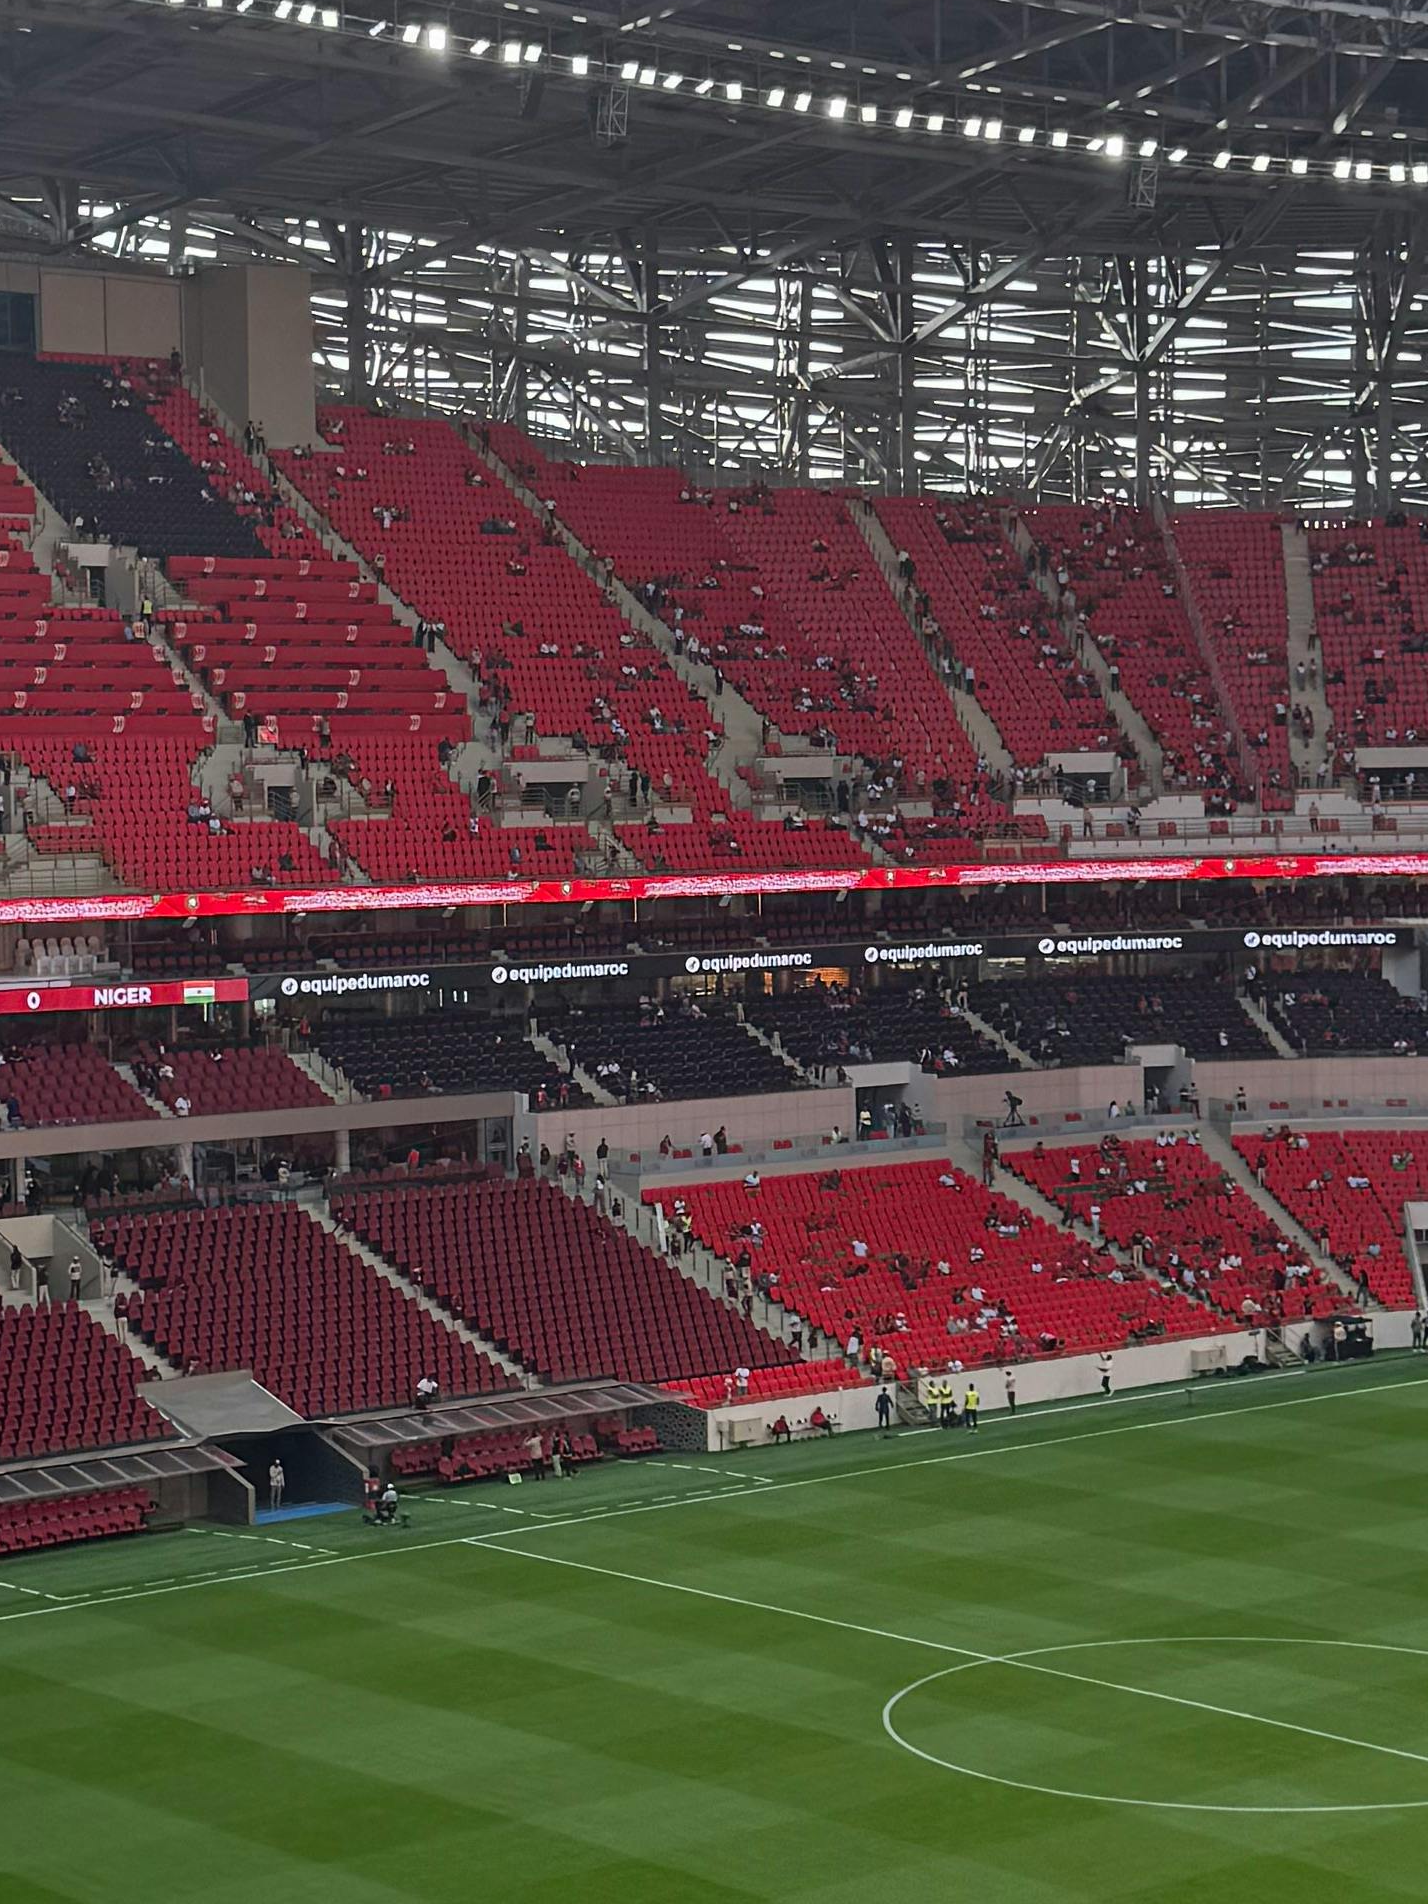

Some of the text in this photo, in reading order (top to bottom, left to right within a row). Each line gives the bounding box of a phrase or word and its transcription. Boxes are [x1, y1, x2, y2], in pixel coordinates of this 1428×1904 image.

[1056, 936, 1183, 956] equipedumaroc
[1261, 930, 1397, 950] equipedumaroc
[700, 952, 814, 974] equipedumaroc
[879, 943, 983, 964] equipedumaroc
[300, 972, 430, 996] equipedumaroc
[509, 963, 629, 985] equipedumaroc
[26, 991, 41, 1010] 0
[94, 986, 152, 1007] NIGER
